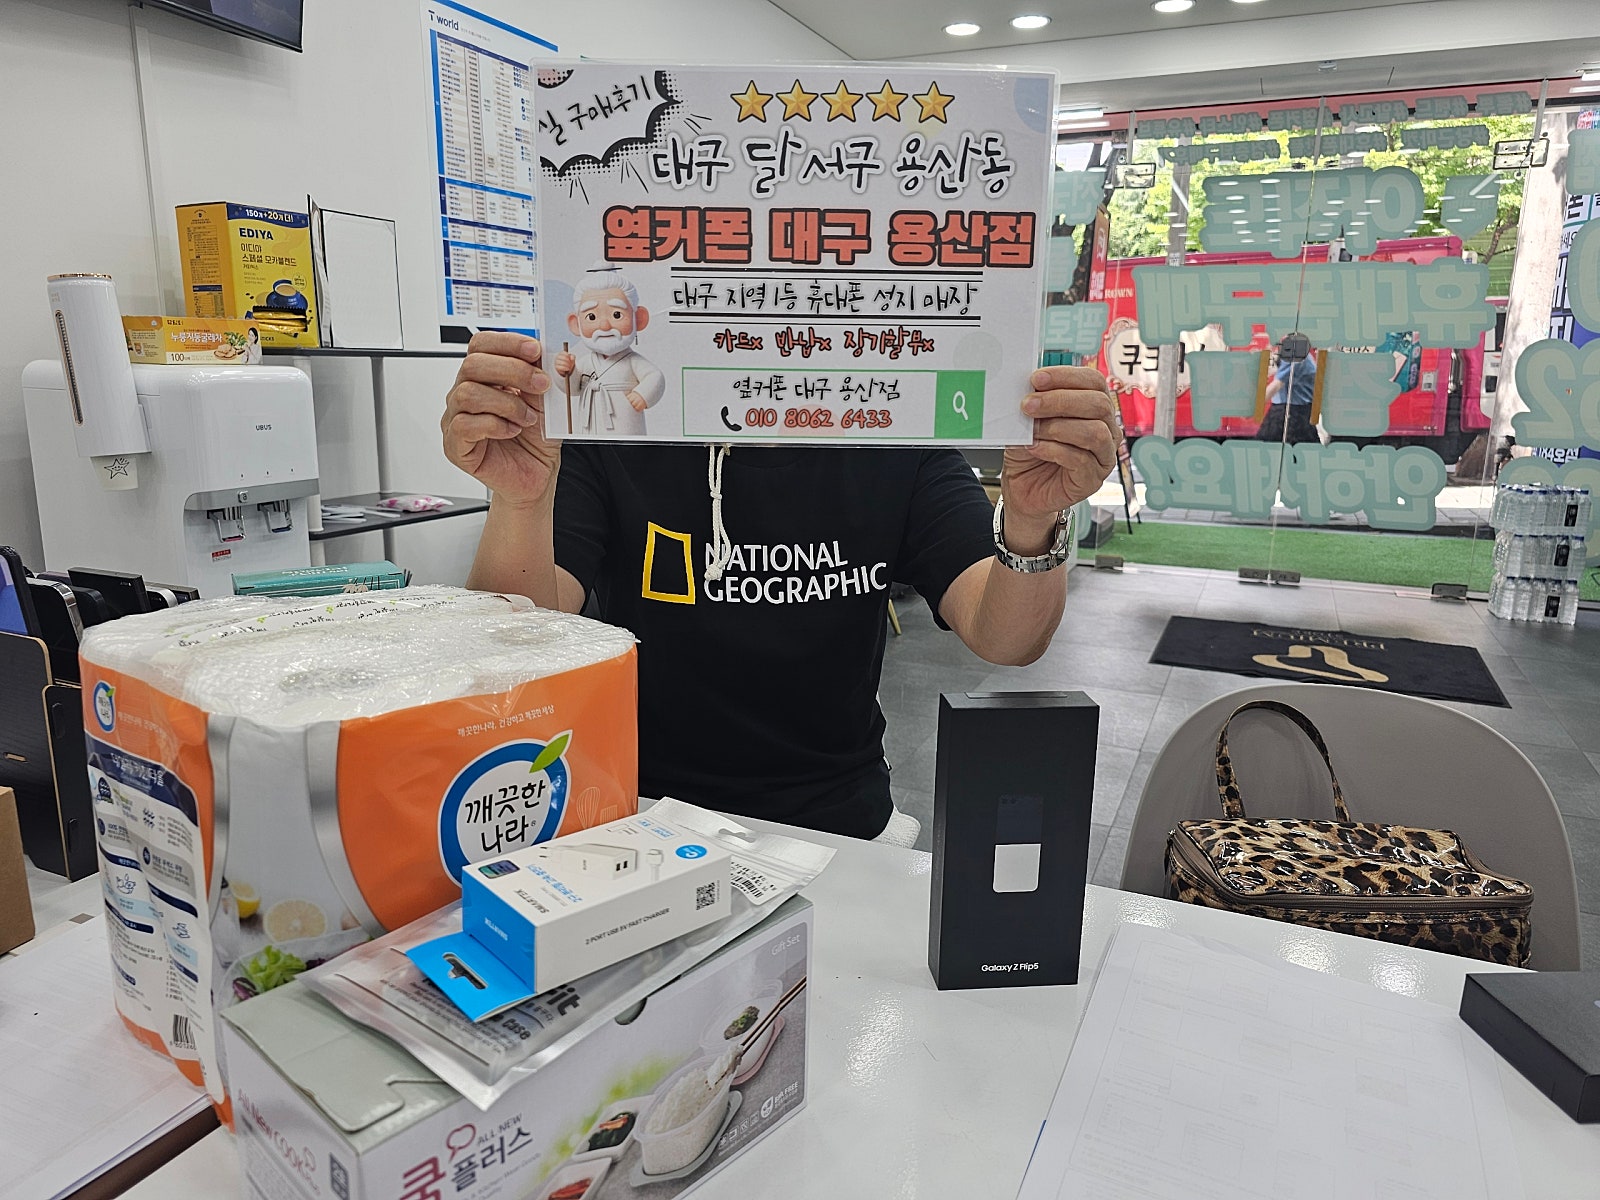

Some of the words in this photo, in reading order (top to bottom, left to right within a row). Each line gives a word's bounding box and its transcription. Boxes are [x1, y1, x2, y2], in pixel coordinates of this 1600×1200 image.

[428, 9, 436, 21] T
[436, 15, 459, 31] world
[538, 107, 567, 146] 실
[568, 76, 651, 132] 구매후기
[654, 136, 731, 186] 대구
[897, 133, 1012, 194] 용산동
[239, 227, 274, 241] EDIYA
[602, 205, 753, 263] 옆커폰
[767, 208, 872, 264] 대구
[888, 211, 1036, 267] 용산점
[673, 284, 718, 310] 대구
[728, 283, 765, 311] 지역
[807, 279, 866, 314] 휴대폰
[873, 285, 916, 313] 성지
[923, 285, 977, 317] 매장
[1105, 287, 1134, 299] ROWN
[733, 376, 784, 402] 옆커폰
[794, 378, 832, 402] 대구
[839, 377, 901, 402] 용산점
[745, 409, 778, 429] 010
[784, 409, 834, 429] 8062
[840, 408, 893, 429] 6433
[705, 541, 848, 572] NATIONAL
[704, 563, 887, 604] GEOGRAPHIC
[465, 779, 546, 824] 깨끗한
[481, 815, 530, 854] 나라
[771, 940, 786, 956] Gift
[786, 934, 801, 948] Set
[981, 964, 1012, 973] Galaxy
[1019, 962, 1039, 972] Flip5
[477, 1129, 497, 1146] ALL
[499, 1113, 523, 1132] NEW
[451, 1127, 534, 1192] 플러스
